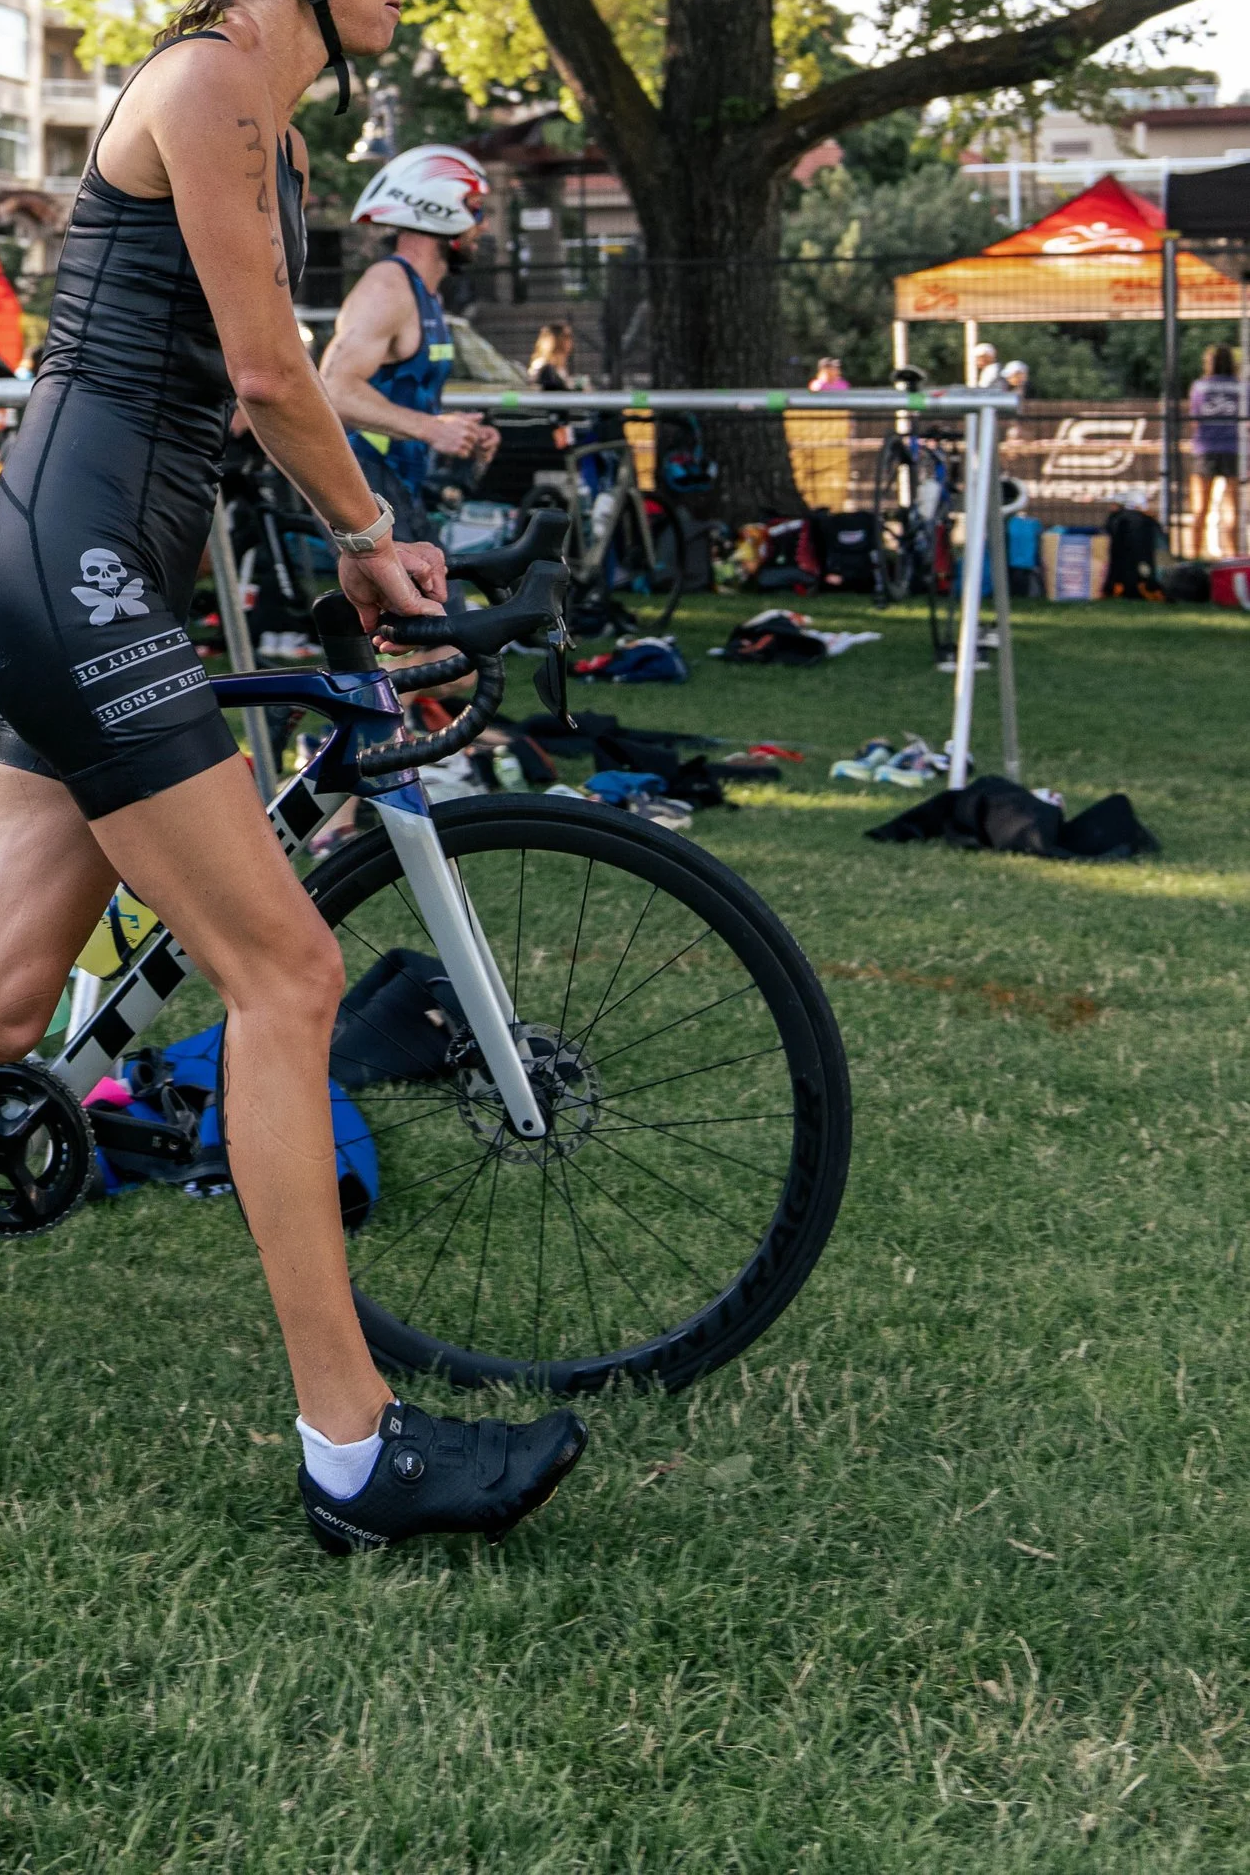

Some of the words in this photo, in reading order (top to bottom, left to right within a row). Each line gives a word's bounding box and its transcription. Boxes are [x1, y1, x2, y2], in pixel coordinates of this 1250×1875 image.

[386, 187, 460, 220] RUDY
[109, 641, 158, 669] BETTY
[313, 1506, 390, 1543] BONTRAGER
